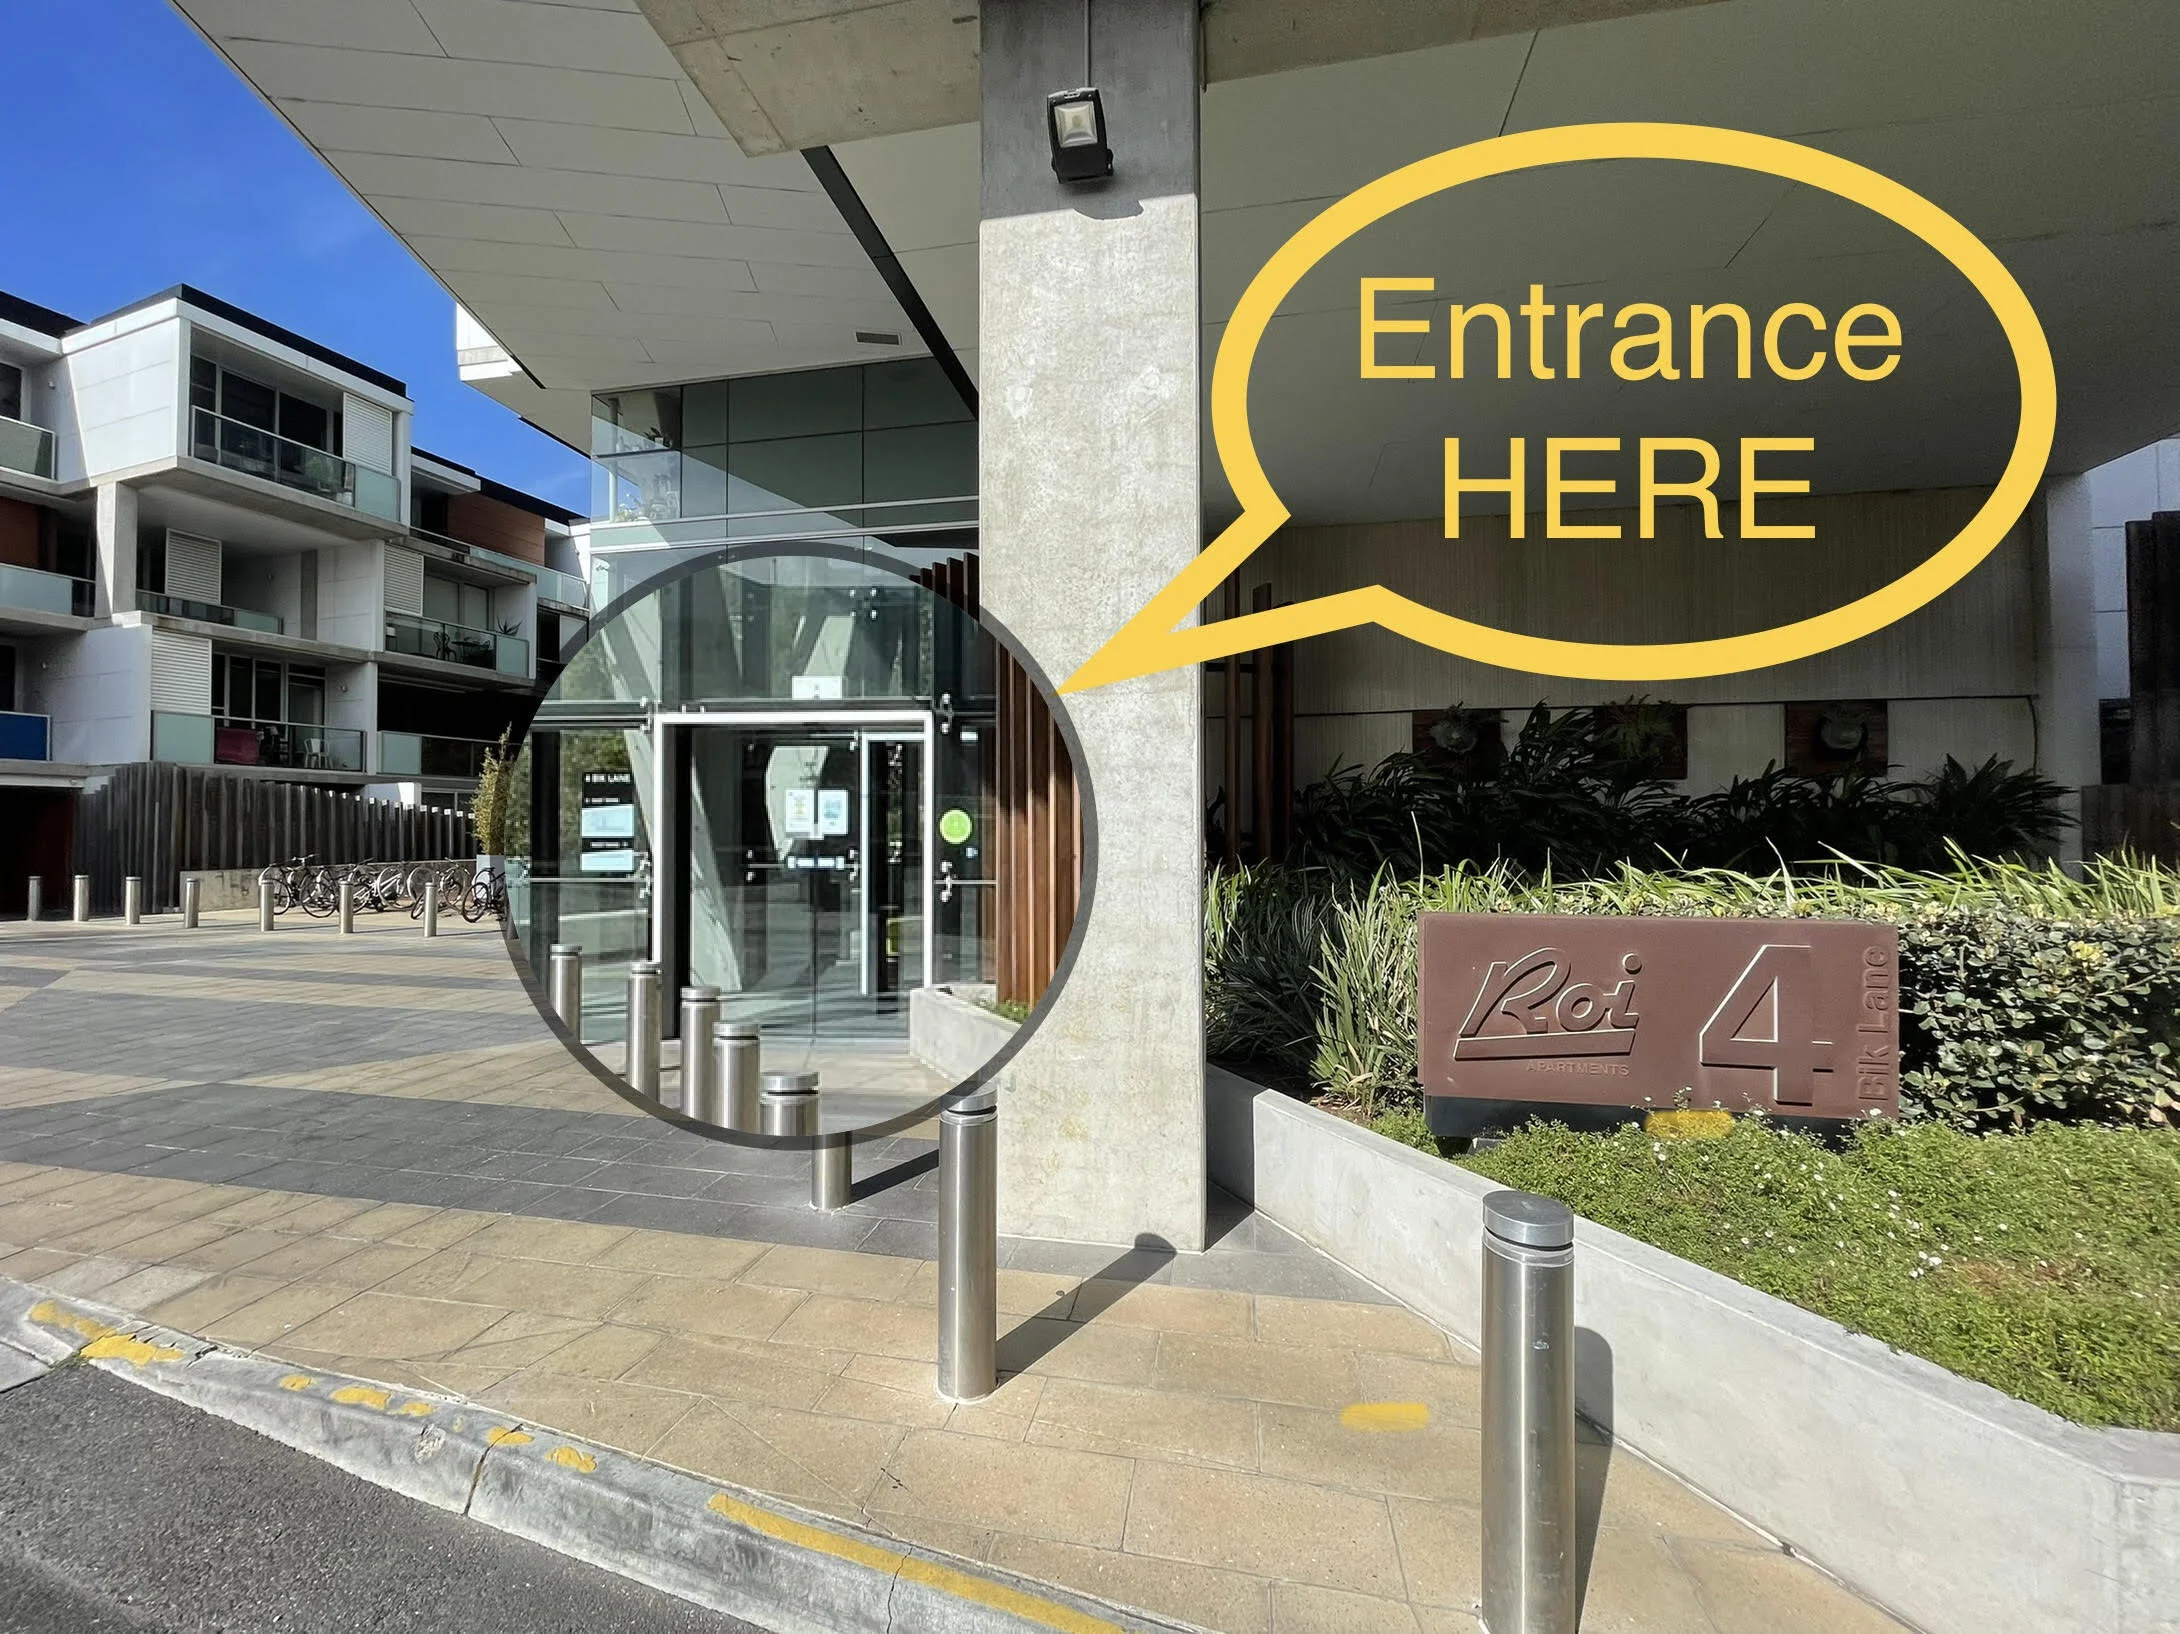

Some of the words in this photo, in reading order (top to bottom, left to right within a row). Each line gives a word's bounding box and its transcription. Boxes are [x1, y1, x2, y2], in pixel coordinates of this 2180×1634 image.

[1457, 946, 1644, 1036] Roi
[1699, 943, 1833, 1107] 4
[1856, 945, 1890, 1034] Lane
[1526, 1060, 1630, 1077] APARTMENTS
[1856, 1045, 1890, 1102] Bik
